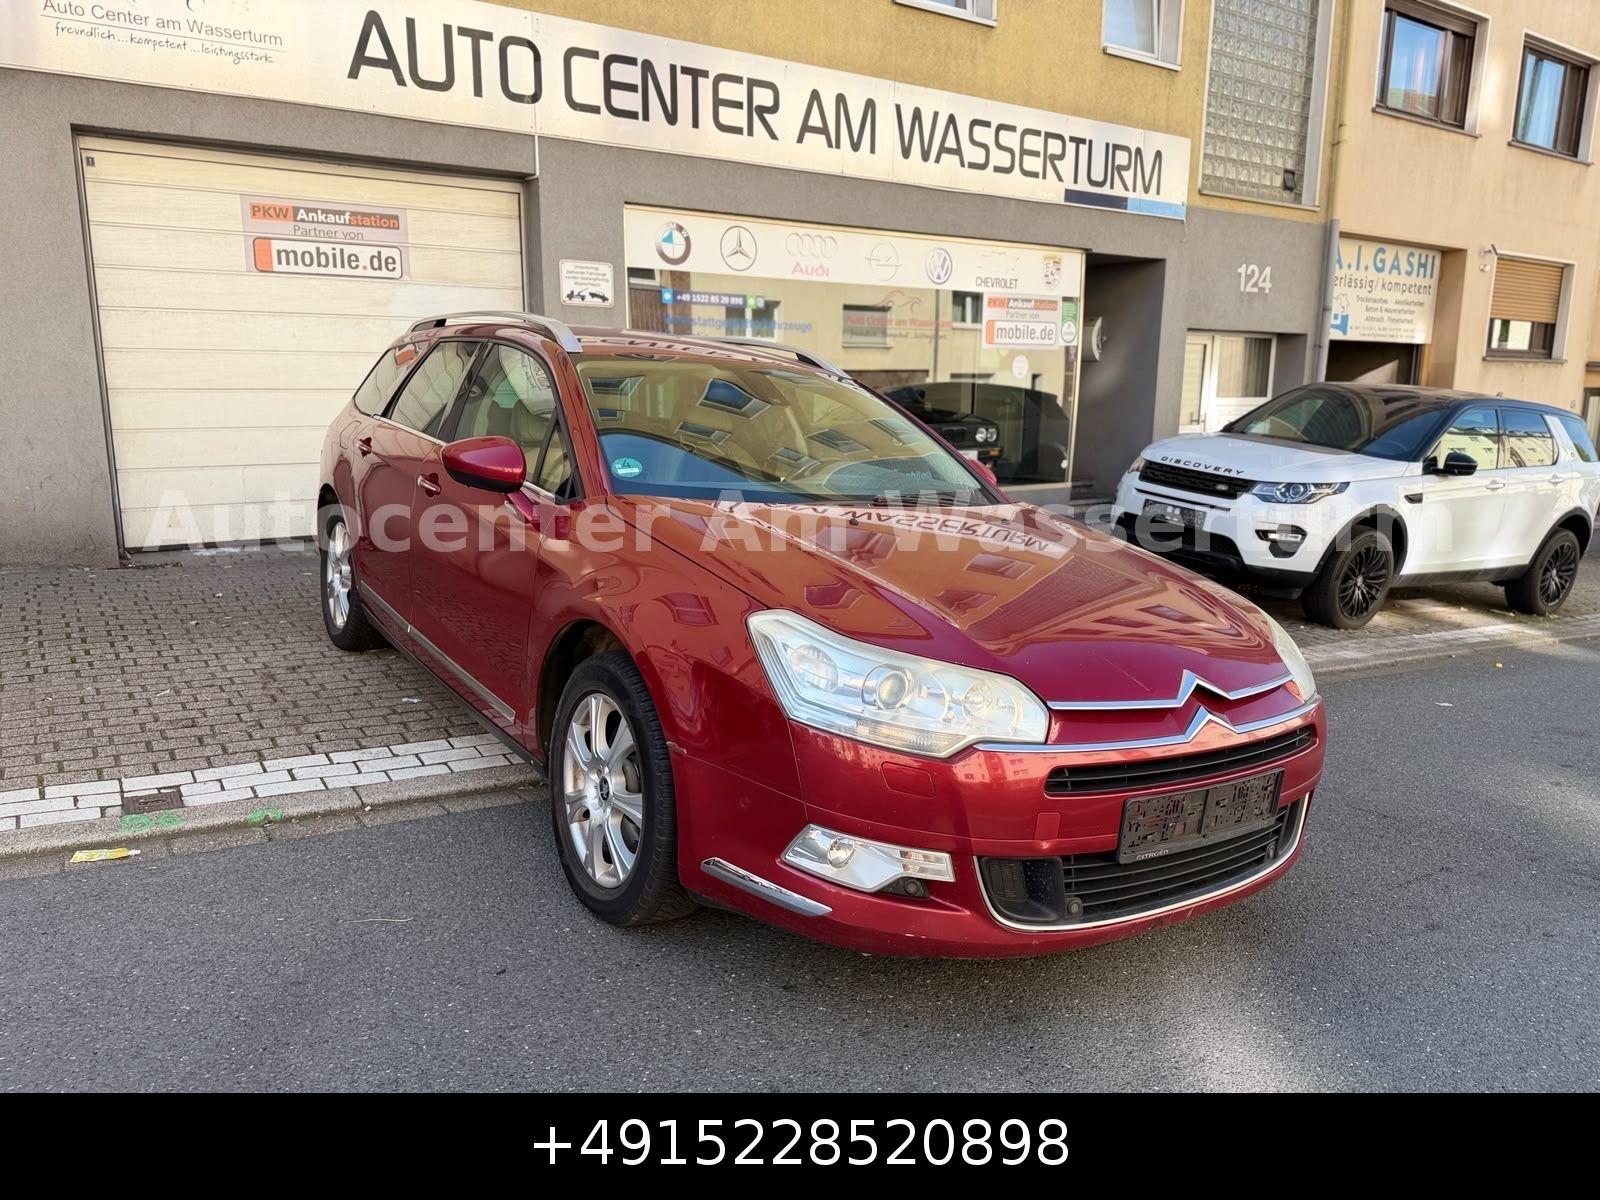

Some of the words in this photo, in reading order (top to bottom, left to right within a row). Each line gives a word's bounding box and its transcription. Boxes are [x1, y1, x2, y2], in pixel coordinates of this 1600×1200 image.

[43, 0, 85, 17] Auto
[91, 4, 150, 27] Center
[155, 17, 182, 32] am
[186, 19, 284, 47] Wasserturm
[347, 9, 543, 105] AUTO
[563, 46, 780, 142] CENTER
[796, 88, 877, 155] AM
[894, 103, 1163, 196] WASSERTURM
[251, 204, 290, 220] PKW
[296, 208, 399, 229] Ankaufstation
[293, 225, 339, 239] Partner
[342, 230, 365, 241] von
[276, 246, 397, 272] mobile.de
[791, 261, 830, 277] Audi
[975, 276, 1019, 290] CHEVROLET
[1237, 264, 1273, 294] 124
[1381, 278, 1432, 296] kompetent
[996, 325, 1054, 341] mobile.de
[1161, 456, 1246, 476] DISCOVERY
